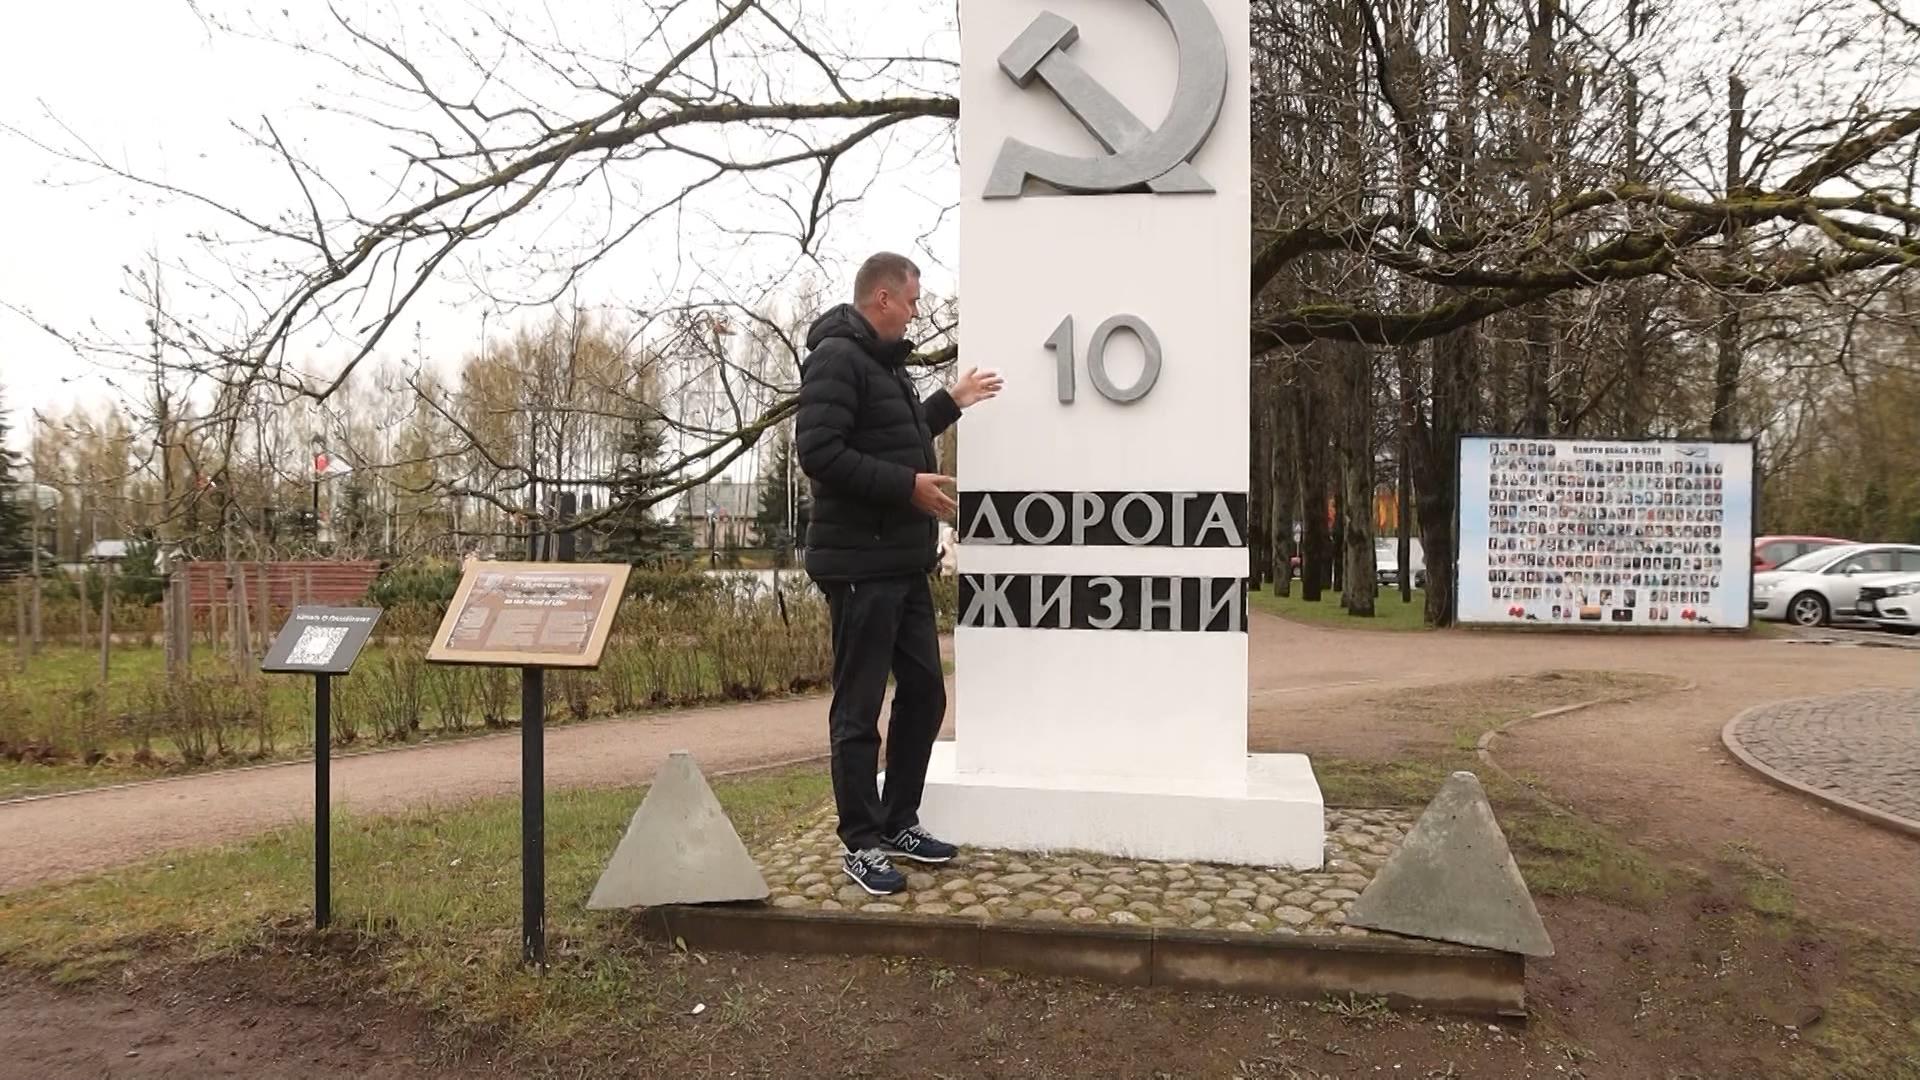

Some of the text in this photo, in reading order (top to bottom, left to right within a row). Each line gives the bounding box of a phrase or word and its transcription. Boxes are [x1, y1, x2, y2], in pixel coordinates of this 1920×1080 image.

[1043, 313, 1162, 404] 10
[960, 492, 1242, 546] ДОРОГА
[961, 575, 1242, 631] ЖИЗНИ
